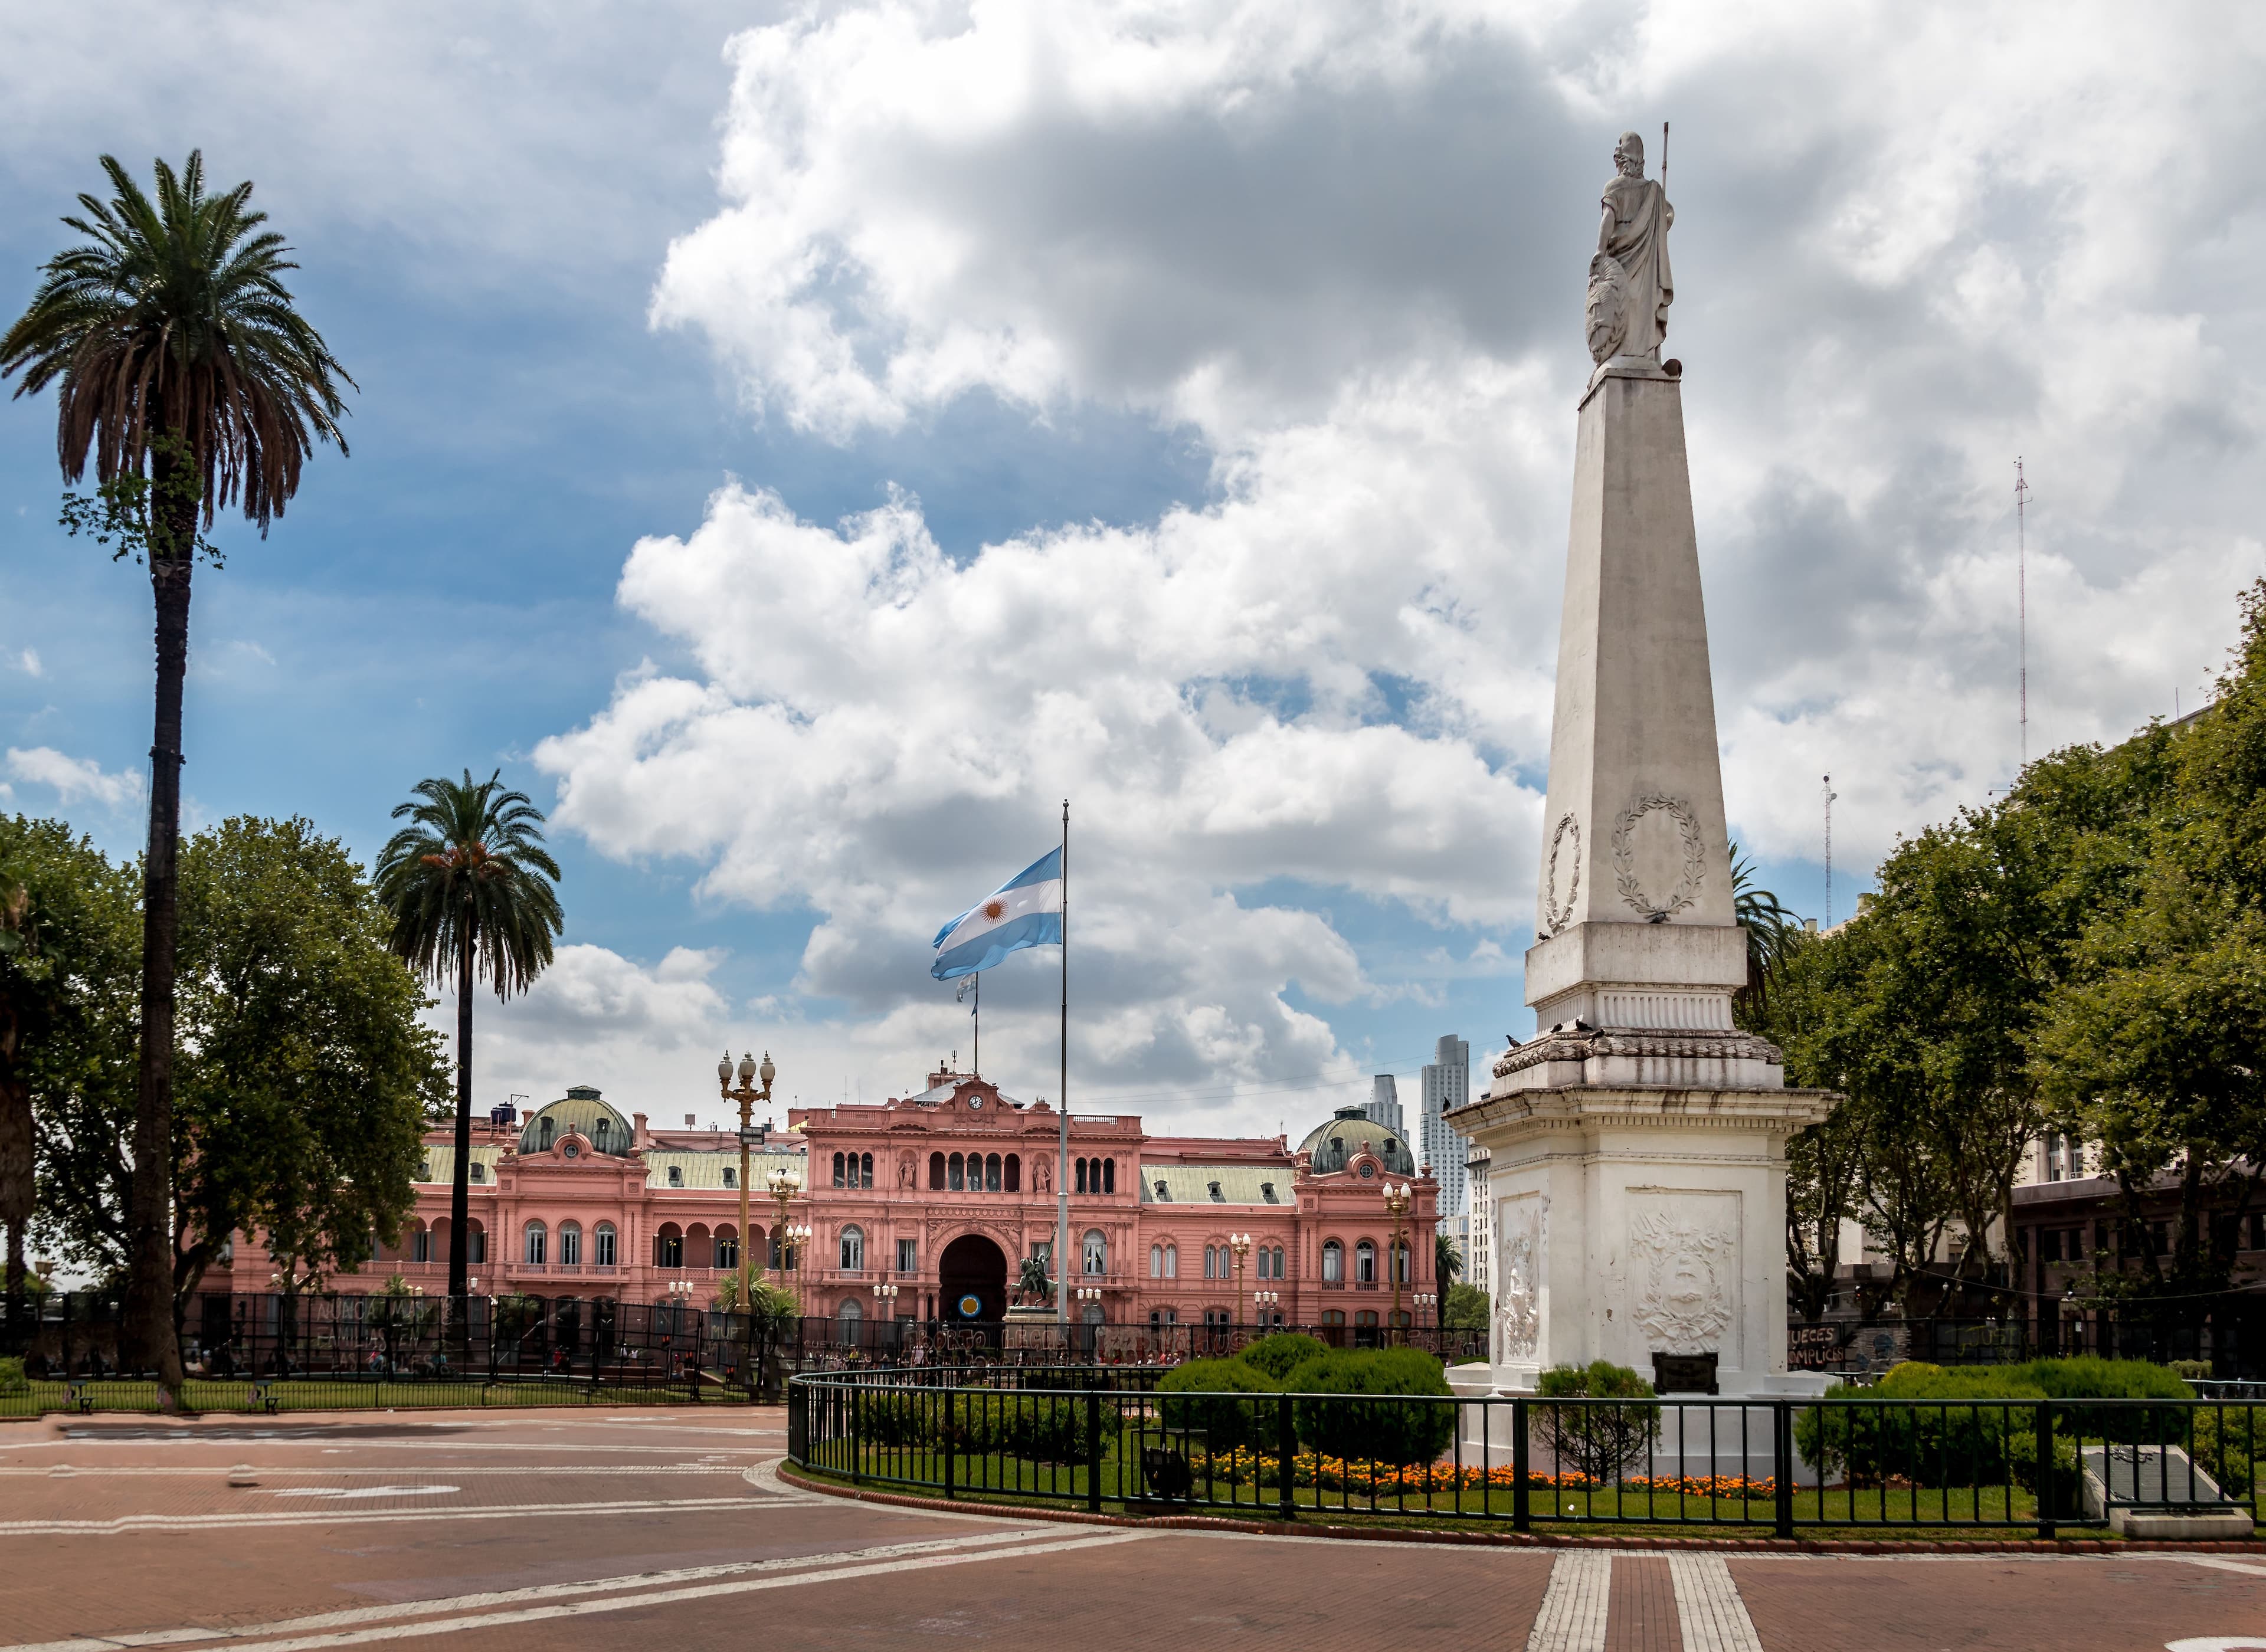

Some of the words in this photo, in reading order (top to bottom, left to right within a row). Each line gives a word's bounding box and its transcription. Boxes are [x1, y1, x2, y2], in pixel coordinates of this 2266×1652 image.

[317, 1327, 387, 1352] FAMILIAS
[903, 1329, 986, 1351] ABORTO
[1001, 1329, 1067, 1350] LEGAL
[1788, 1328, 1835, 1345] UECES
